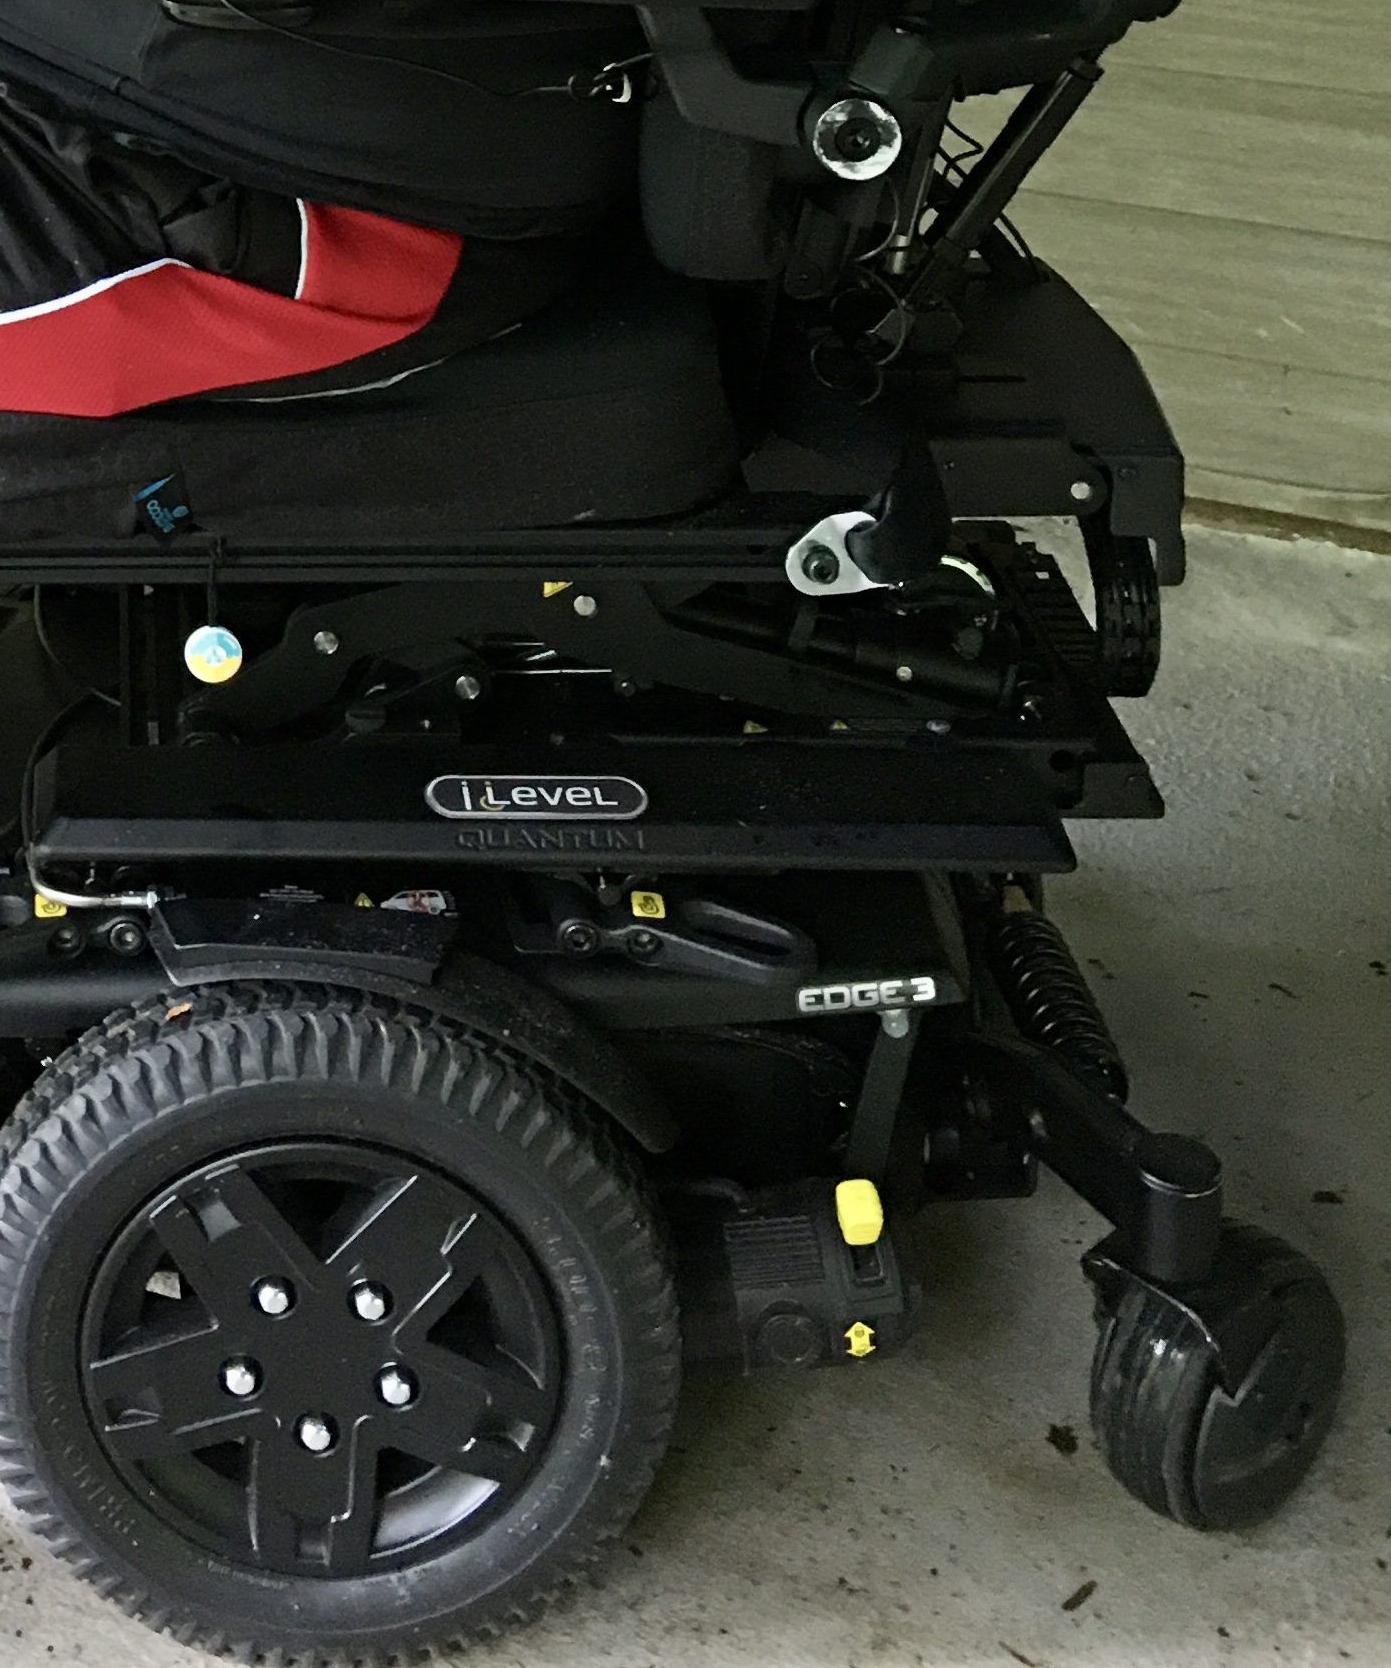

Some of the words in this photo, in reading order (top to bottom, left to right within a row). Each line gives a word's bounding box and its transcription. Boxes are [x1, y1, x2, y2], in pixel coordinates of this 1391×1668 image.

[457, 828, 646, 849] QUANTUM
[798, 980, 906, 1012] EDGE
[910, 976, 936, 1002] 3
